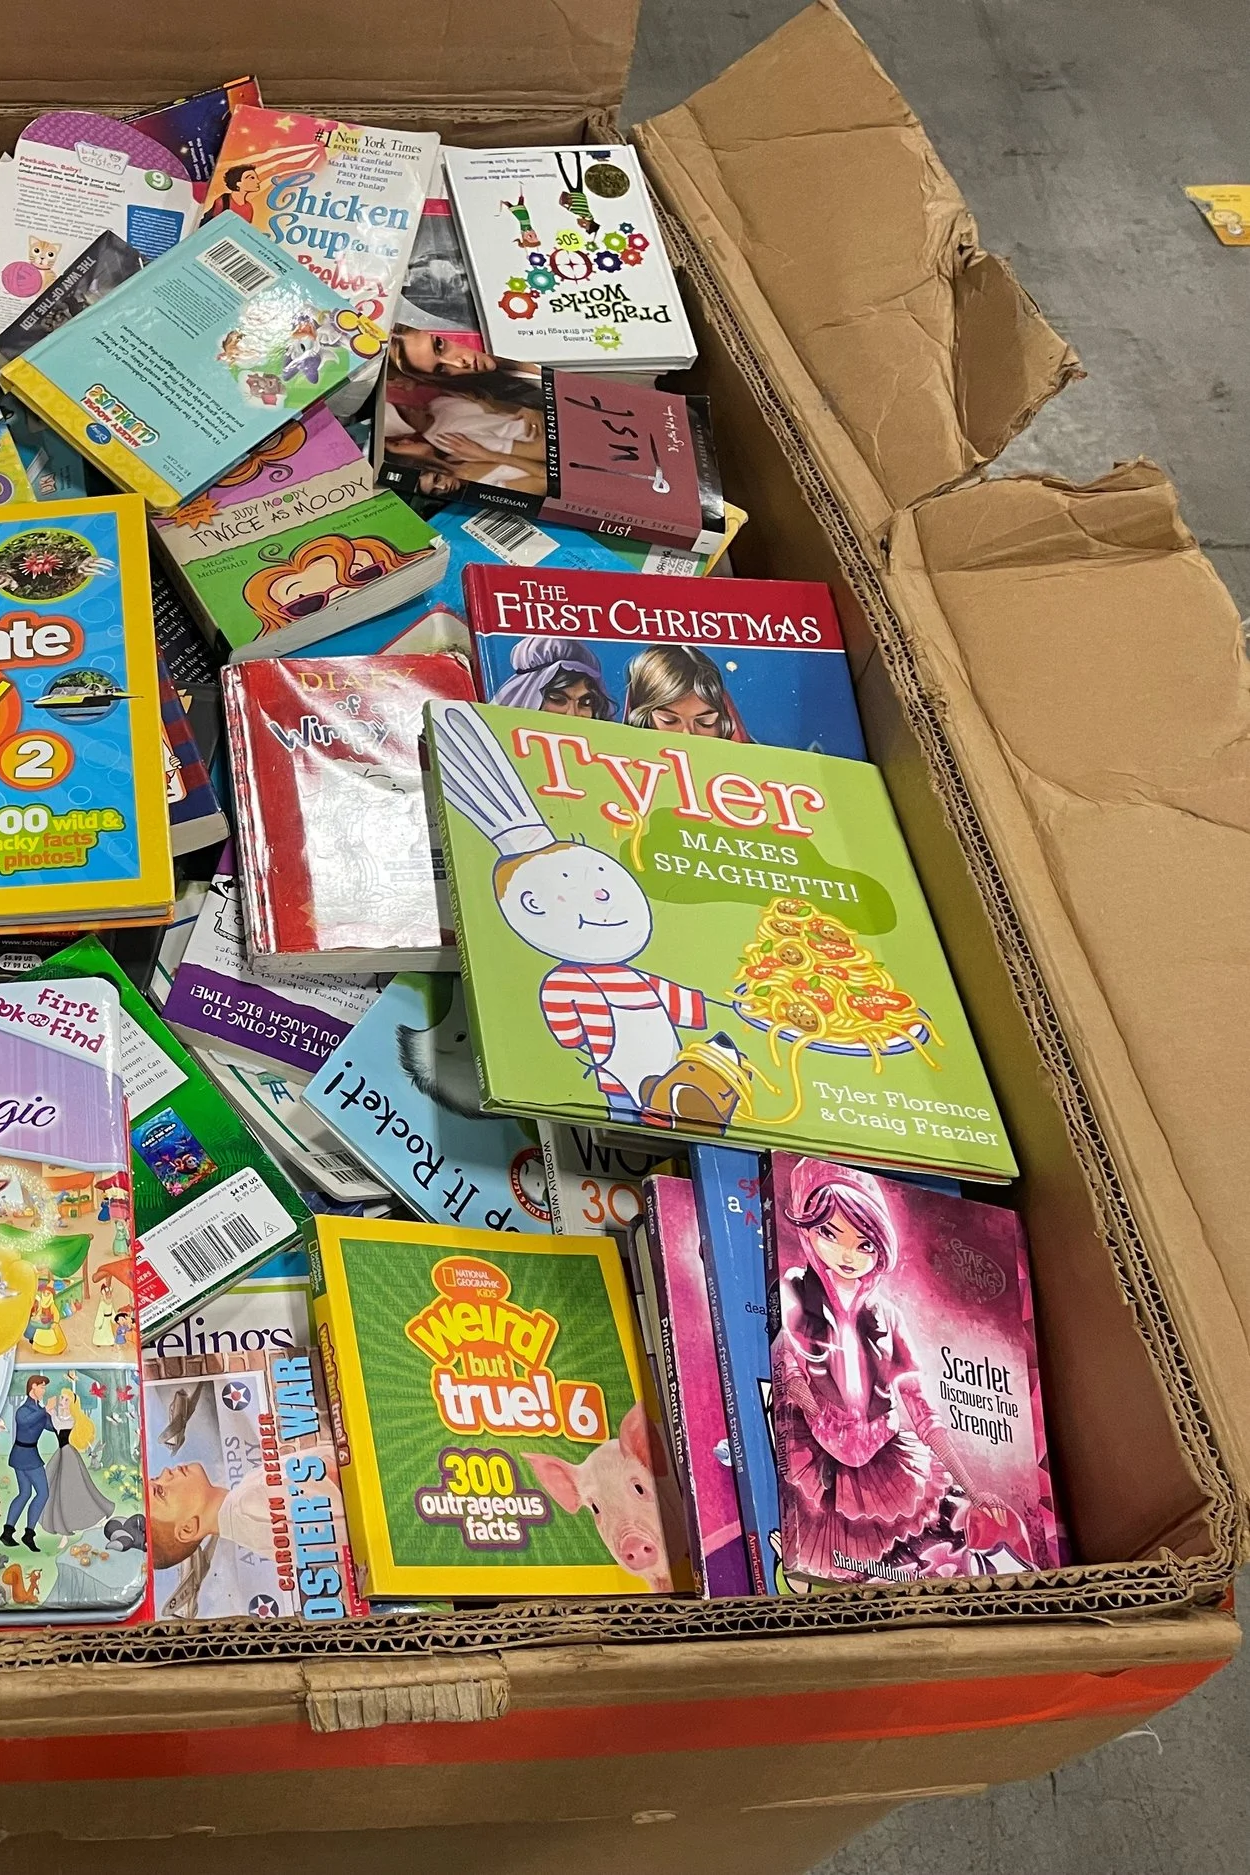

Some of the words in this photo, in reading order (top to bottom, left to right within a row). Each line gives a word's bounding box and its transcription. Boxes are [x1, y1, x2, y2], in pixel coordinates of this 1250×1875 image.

[335, 131, 360, 145] New
[364, 135, 386, 150] York
[390, 138, 422, 154] Times
[383, 151, 420, 162] AUTHORS
[342, 153, 358, 163] Jack
[360, 156, 392, 167] Canfield
[374, 166, 403, 177] Hansen
[336, 178, 356, 188] Irene
[357, 181, 386, 192] Dunlap
[337, 170, 357, 181] Patty
[359, 172, 388, 184] Hansen
[267, 172, 409, 230] Chicken
[269, 213, 351, 259] Soup
[62, 271, 82, 290] WAY
[77, 256, 97, 274] THE
[35, 298, 56, 316] THE
[549, 283, 632, 314] Works
[584, 301, 673, 324] Prayer
[20, 311, 40, 331] JEDI
[546, 405, 558, 441] DEADLY
[548, 450, 559, 478] SEVEN
[188, 516, 267, 548] TWICE
[271, 507, 292, 524] AS
[294, 475, 372, 517] MOODY
[231, 503, 261, 522] JUDY
[262, 486, 311, 513] MOODY
[479, 492, 529, 509] WASSERMAN
[598, 519, 633, 538] Lust
[519, 580, 568, 603] THE
[493, 592, 603, 636] FIRST
[608, 599, 822, 645] CHRISTMAS
[297, 667, 417, 693] DIARY
[15, 740, 55, 779] 2
[513, 727, 825, 839] Tyler
[52, 812, 98, 832] wild
[101, 811, 123, 829] &
[43, 831, 94, 848] facts
[679, 829, 800, 867] MAKES
[4, 848, 84, 871] photos!
[654, 852, 859, 903] SPAGHETTI!
[190, 983, 231, 1007] TIME!
[237, 1000, 263, 1018] BIG
[202, 1003, 222, 1020] TO
[227, 1012, 278, 1039] GOING
[49, 1019, 107, 1055] Find
[280, 1030, 298, 1047] IS
[476, 1055, 486, 1090] HARPER
[812, 1081, 878, 1106] Tyler
[883, 1090, 991, 1122] Florence
[323, 1060, 446, 1191] Rocket!
[820, 1107, 837, 1122] &
[839, 1107, 907, 1136] Craig
[911, 1117, 999, 1147] Frazier
[544, 1139, 557, 1188] WORDLY
[229, 1183, 249, 1197] $4.99
[249, 1176, 260, 1185] US
[249, 1183, 263, 1194] CAN
[441, 1167, 480, 1224] It,
[455, 1268, 489, 1280] NATIONAL
[456, 1277, 501, 1289] GEOGRAPHIC
[414, 1302, 550, 1363] weird
[661, 1317, 675, 1380] Princess
[468, 1352, 507, 1379] but
[940, 1346, 1014, 1397] Scarlet
[273, 1355, 320, 1442] WAR
[438, 1373, 556, 1428] true!
[568, 1388, 599, 1437] 6
[667, 1380, 680, 1423] Potty
[711, 1305, 721, 1337] guide
[728, 1416, 745, 1474] troubles
[939, 1380, 994, 1414] Discovers
[995, 1394, 1019, 1419] True
[949, 1404, 1015, 1445] Strength
[259, 1413, 284, 1487] REEDER
[675, 1424, 685, 1466] Time
[444, 1455, 514, 1496] 300
[421, 1493, 544, 1520] outrageous
[269, 1496, 296, 1592] CAROLYN
[285, 1455, 345, 1620] OSTER'S
[465, 1516, 521, 1543] facts
[748, 1534, 761, 1580] American
[832, 1550, 866, 1574] Shana
